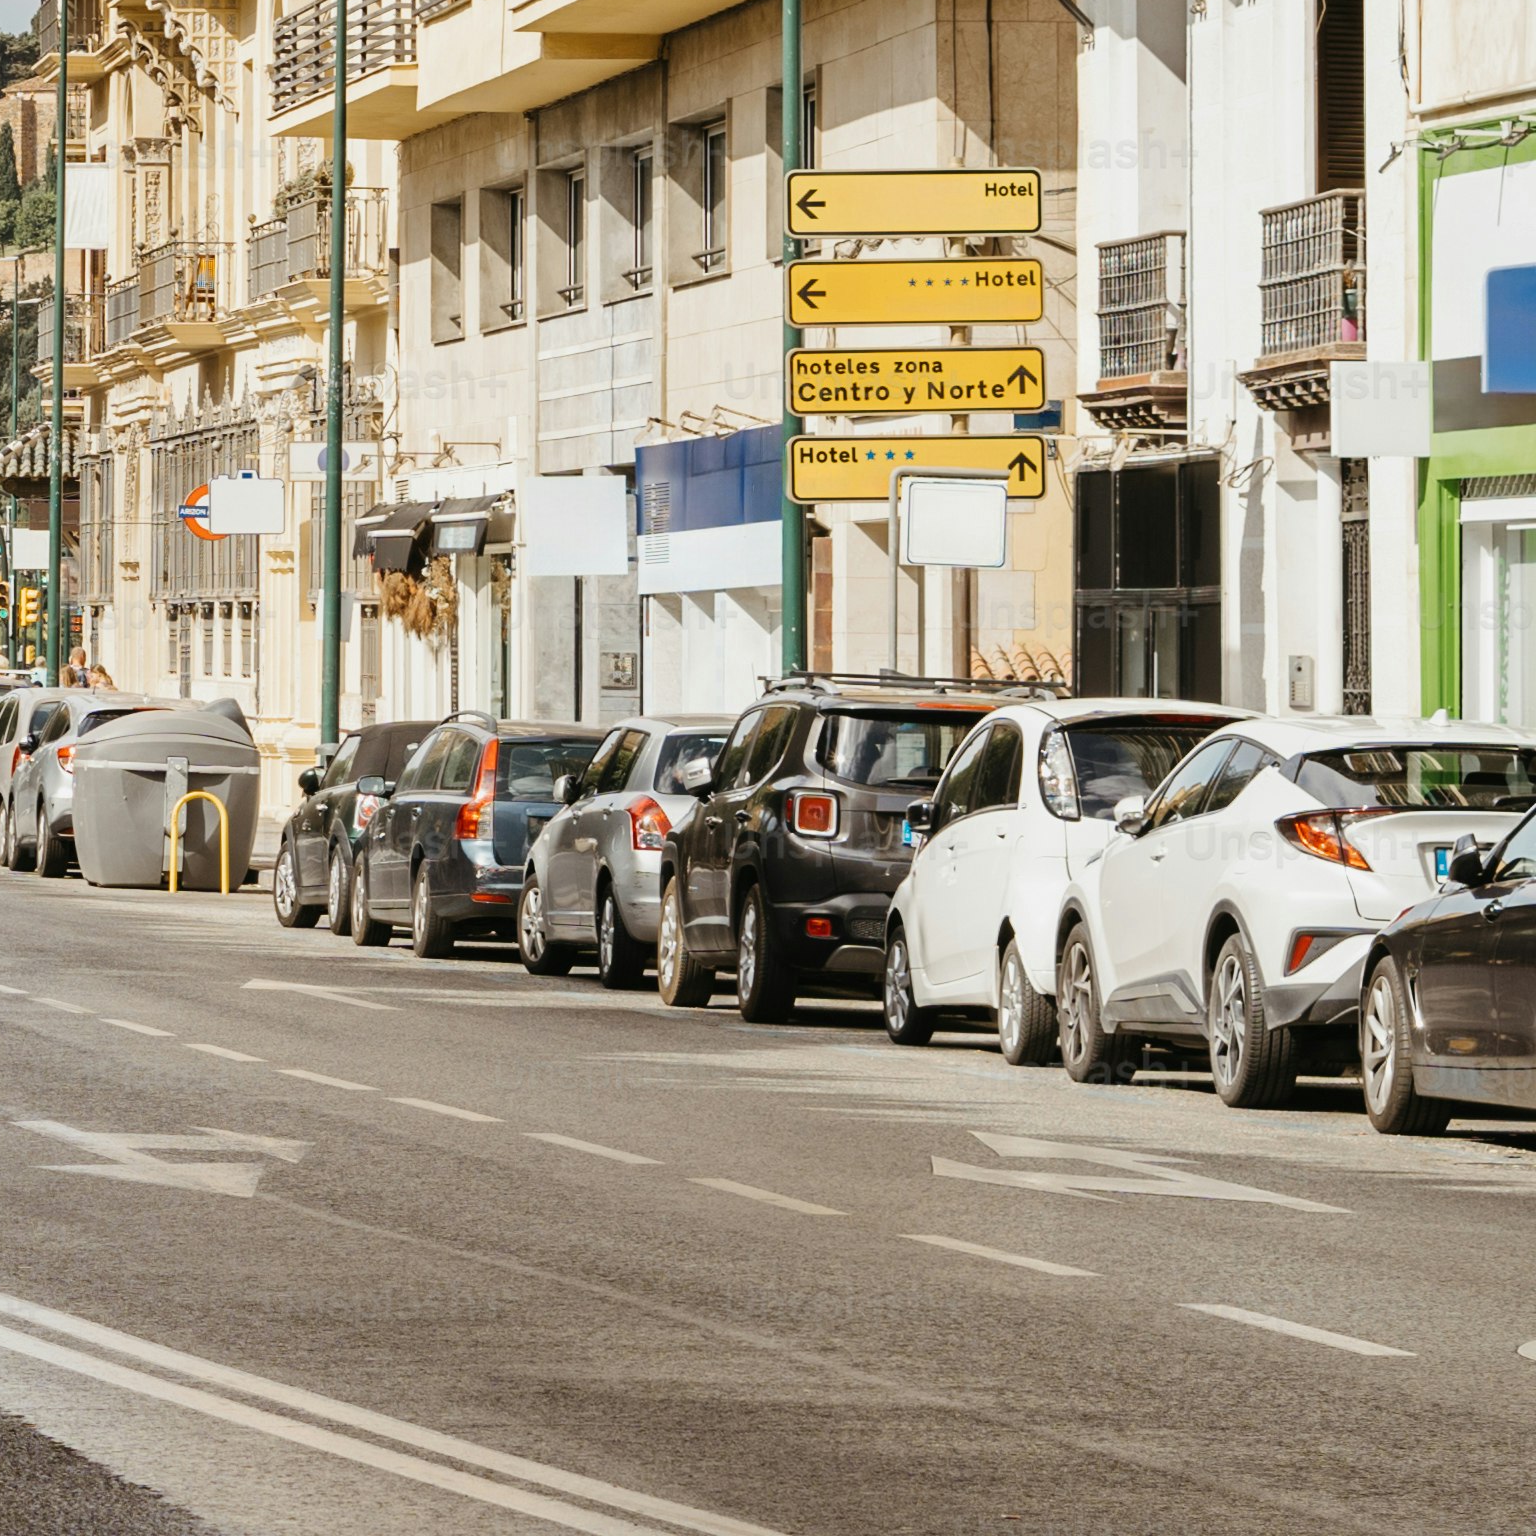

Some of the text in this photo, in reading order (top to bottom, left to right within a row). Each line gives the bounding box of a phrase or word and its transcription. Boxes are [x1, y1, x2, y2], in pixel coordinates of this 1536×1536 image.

[984, 182, 1034, 198] Hotel
[975, 270, 1037, 287] Hotel
[796, 358, 943, 375] hoteles zona
[798, 382, 889, 403] Centro
[903, 385, 915, 404] y
[927, 380, 1006, 401] Norte
[799, 447, 858, 464] Hotel
[179, 508, 208, 516] ARIZON
